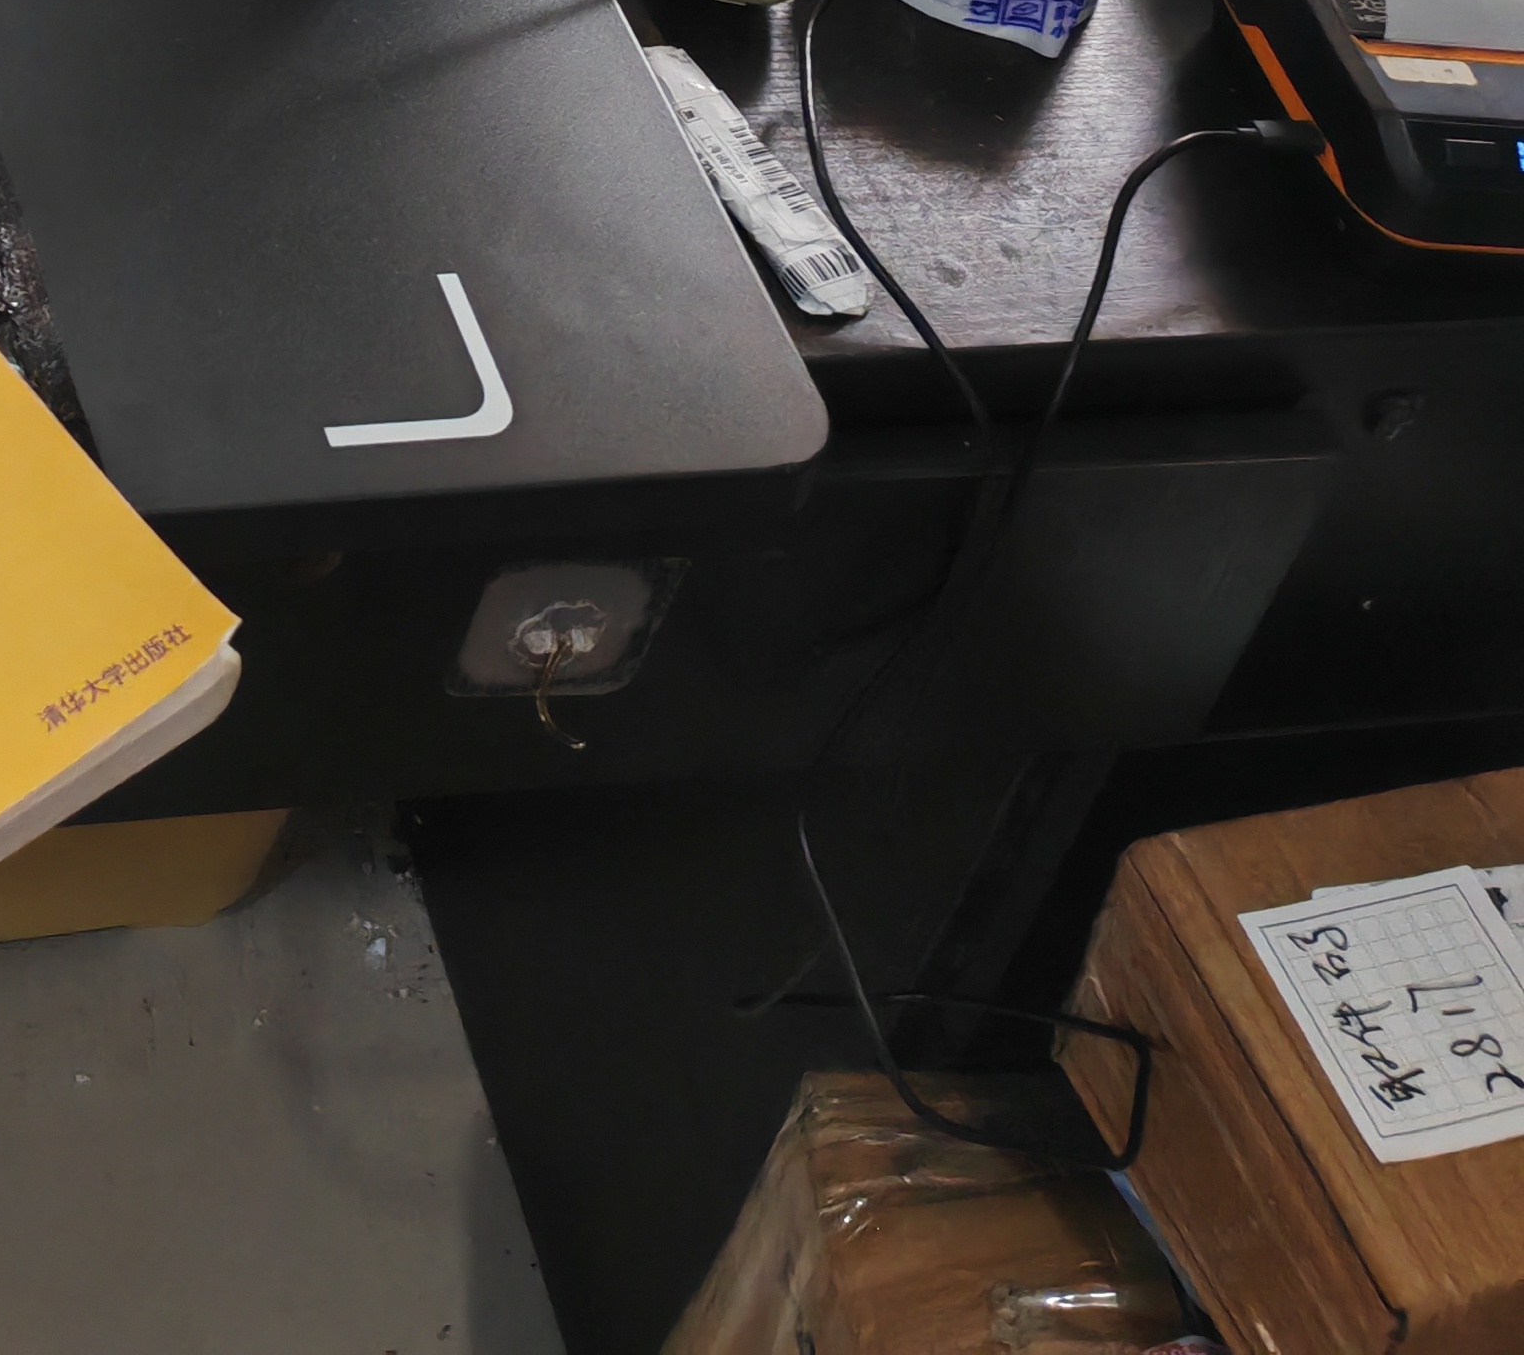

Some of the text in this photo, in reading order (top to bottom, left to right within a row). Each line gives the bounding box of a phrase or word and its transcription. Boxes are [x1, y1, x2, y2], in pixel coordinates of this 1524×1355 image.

[36, 622, 193, 733] 清华大学出版社
[1287, 926, 1426, 1111] 取件码
[1406, 975, 1524, 1094] 2817
